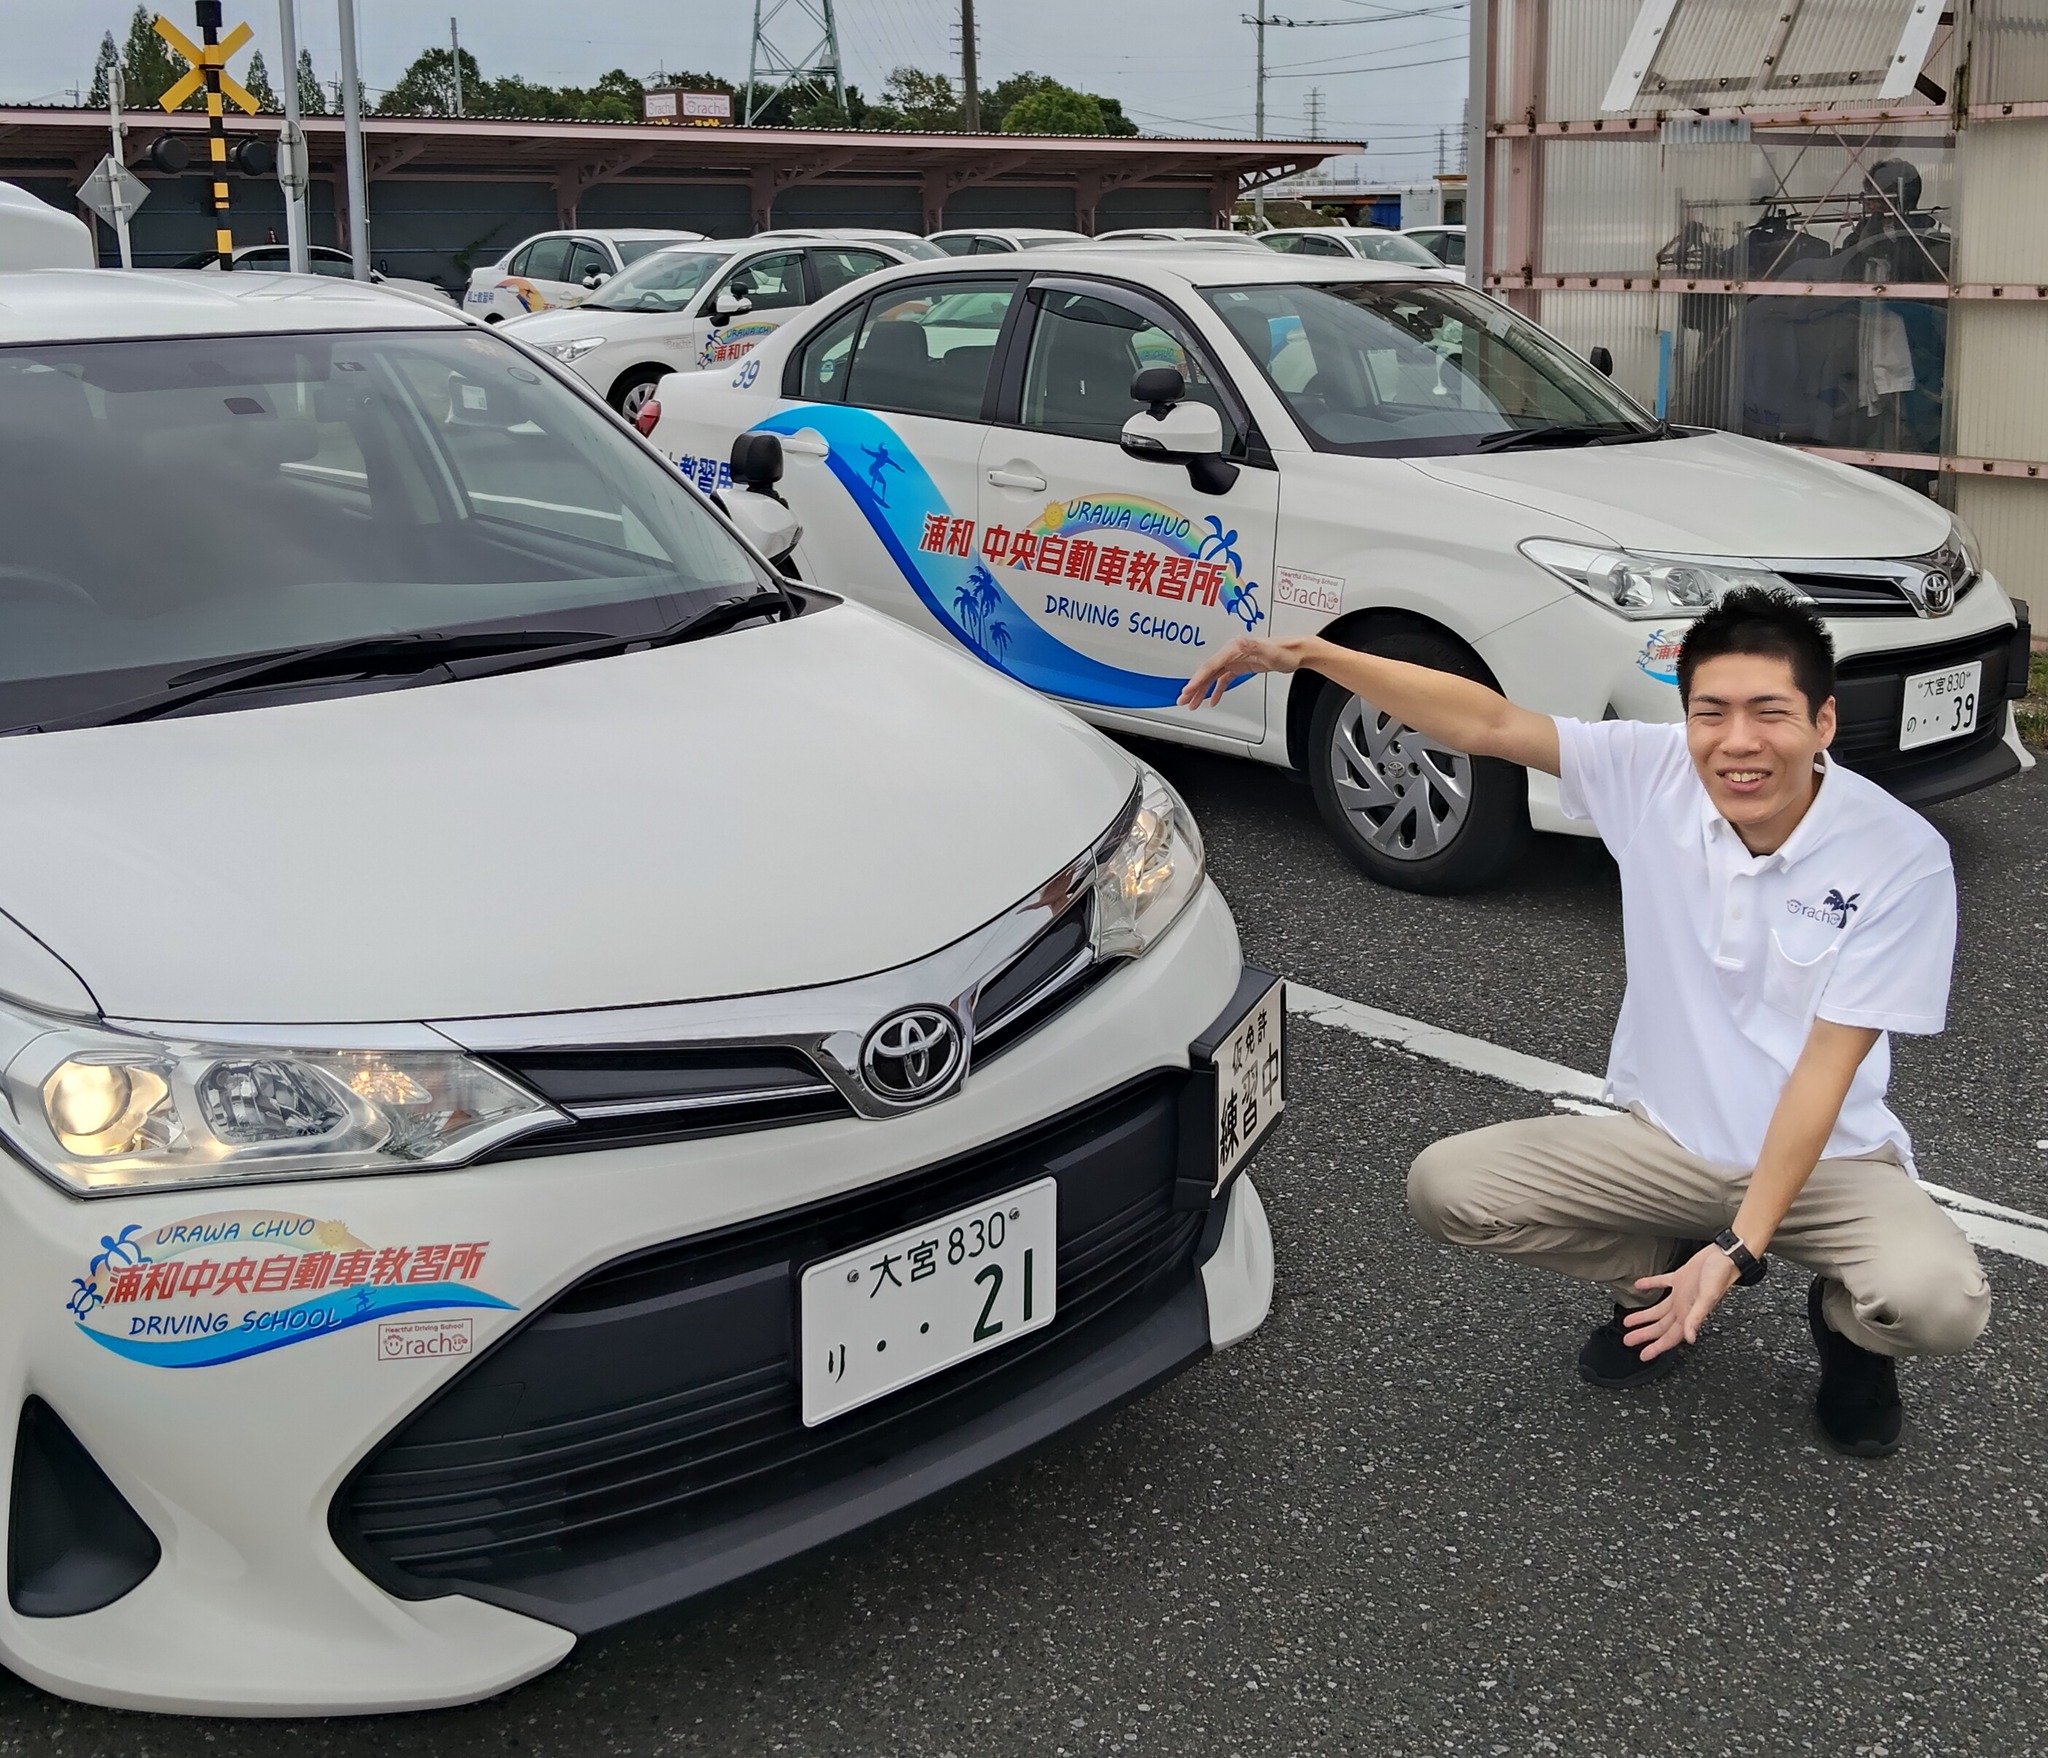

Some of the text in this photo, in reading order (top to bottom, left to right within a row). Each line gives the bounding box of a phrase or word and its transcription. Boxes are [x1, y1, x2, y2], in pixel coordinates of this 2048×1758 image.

[732, 359, 761, 389] 39
[1067, 501, 1191, 539] URAWA CHUO
[1045, 595, 1206, 647] DRIVING SCHOOL
[1220, 1042, 1279, 1168] 練習中
[156, 1218, 316, 1246] URAWA CHUO
[103, 1241, 490, 1305] 浦和中央自動車教習所
[129, 1306, 343, 1336] DRIVING SCHOOL
[385, 1326, 413, 1334] Heartful
